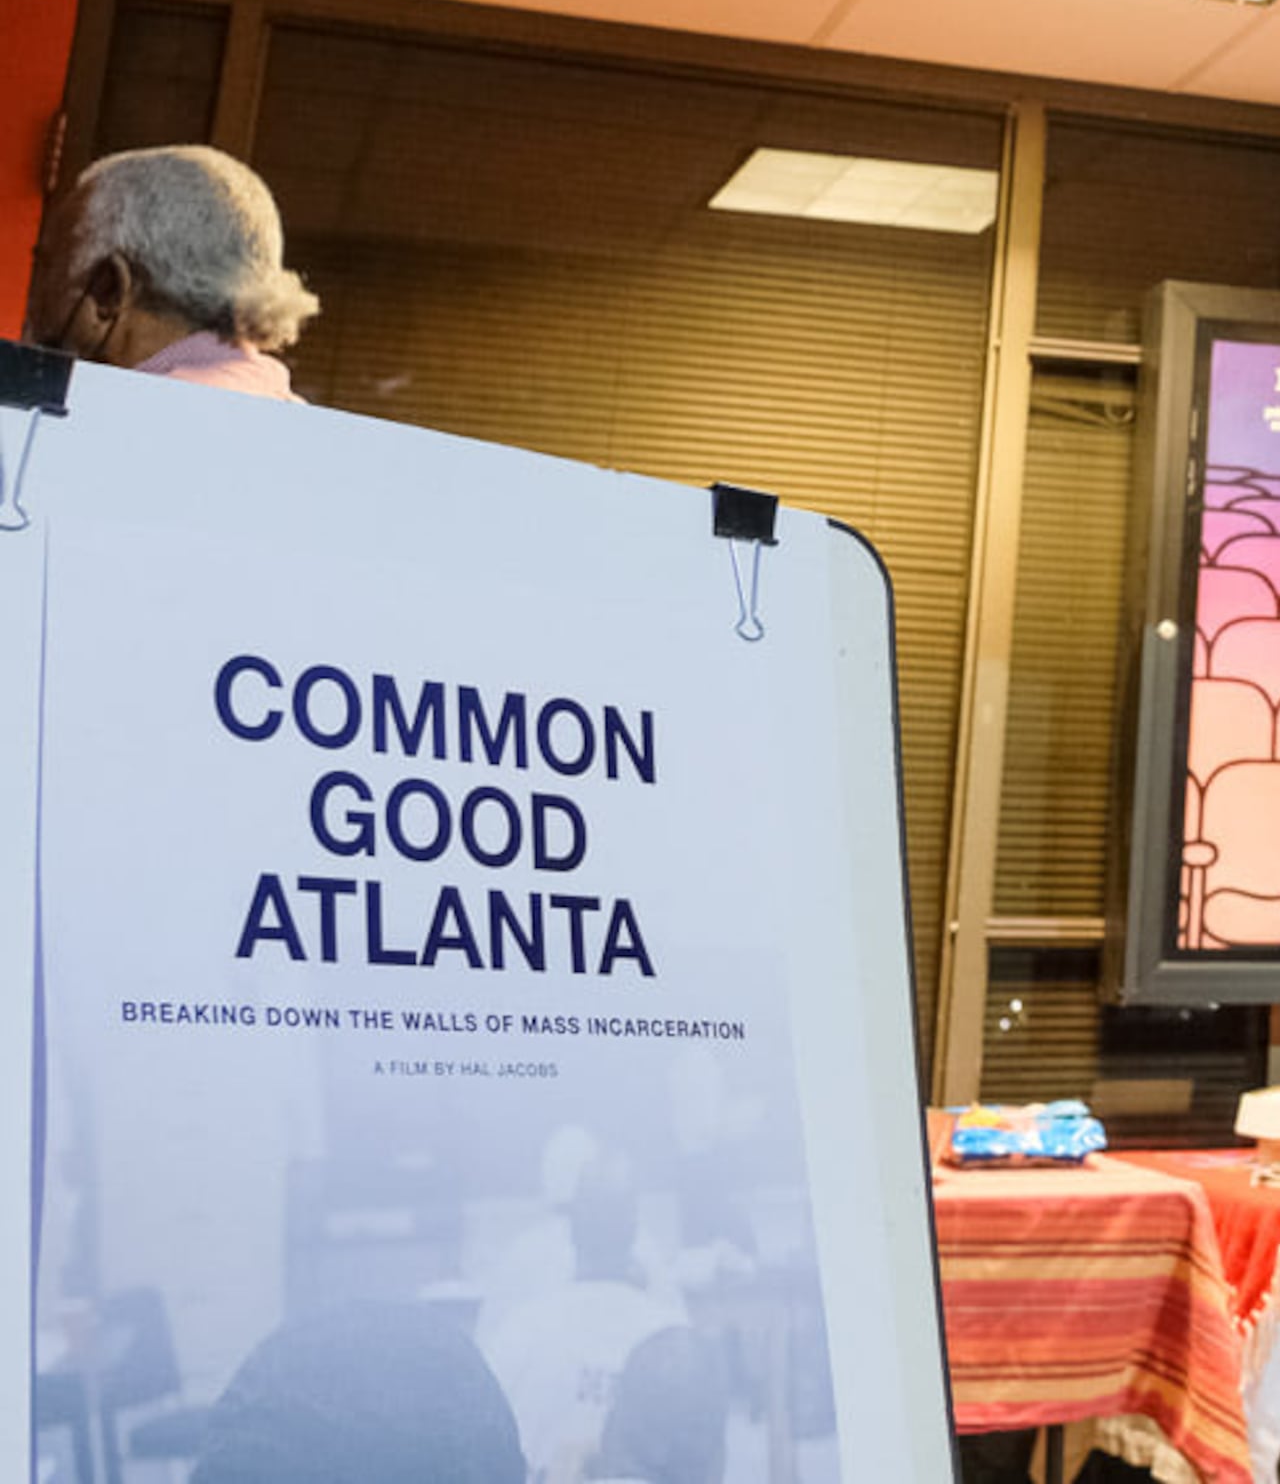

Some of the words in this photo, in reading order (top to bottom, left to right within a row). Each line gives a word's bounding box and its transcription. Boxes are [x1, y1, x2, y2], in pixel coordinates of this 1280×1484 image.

[213, 654, 657, 785] COMMON
[309, 770, 587, 873] GOOD
[234, 872, 657, 978] ATLANTA
[121, 1001, 256, 1027] BREAKING
[266, 1006, 341, 1029] DOWN
[347, 1009, 395, 1030] THE
[401, 1012, 478, 1033] WALLS
[485, 1014, 515, 1033] OF
[521, 1015, 581, 1035] MASS
[587, 1017, 746, 1040] INCARCERATION
[373, 1060, 385, 1075] A
[390, 1061, 429, 1076] FILM
[434, 1062, 455, 1076] BY
[460, 1062, 490, 1077] HAL
[496, 1063, 560, 1078] JACOBS
